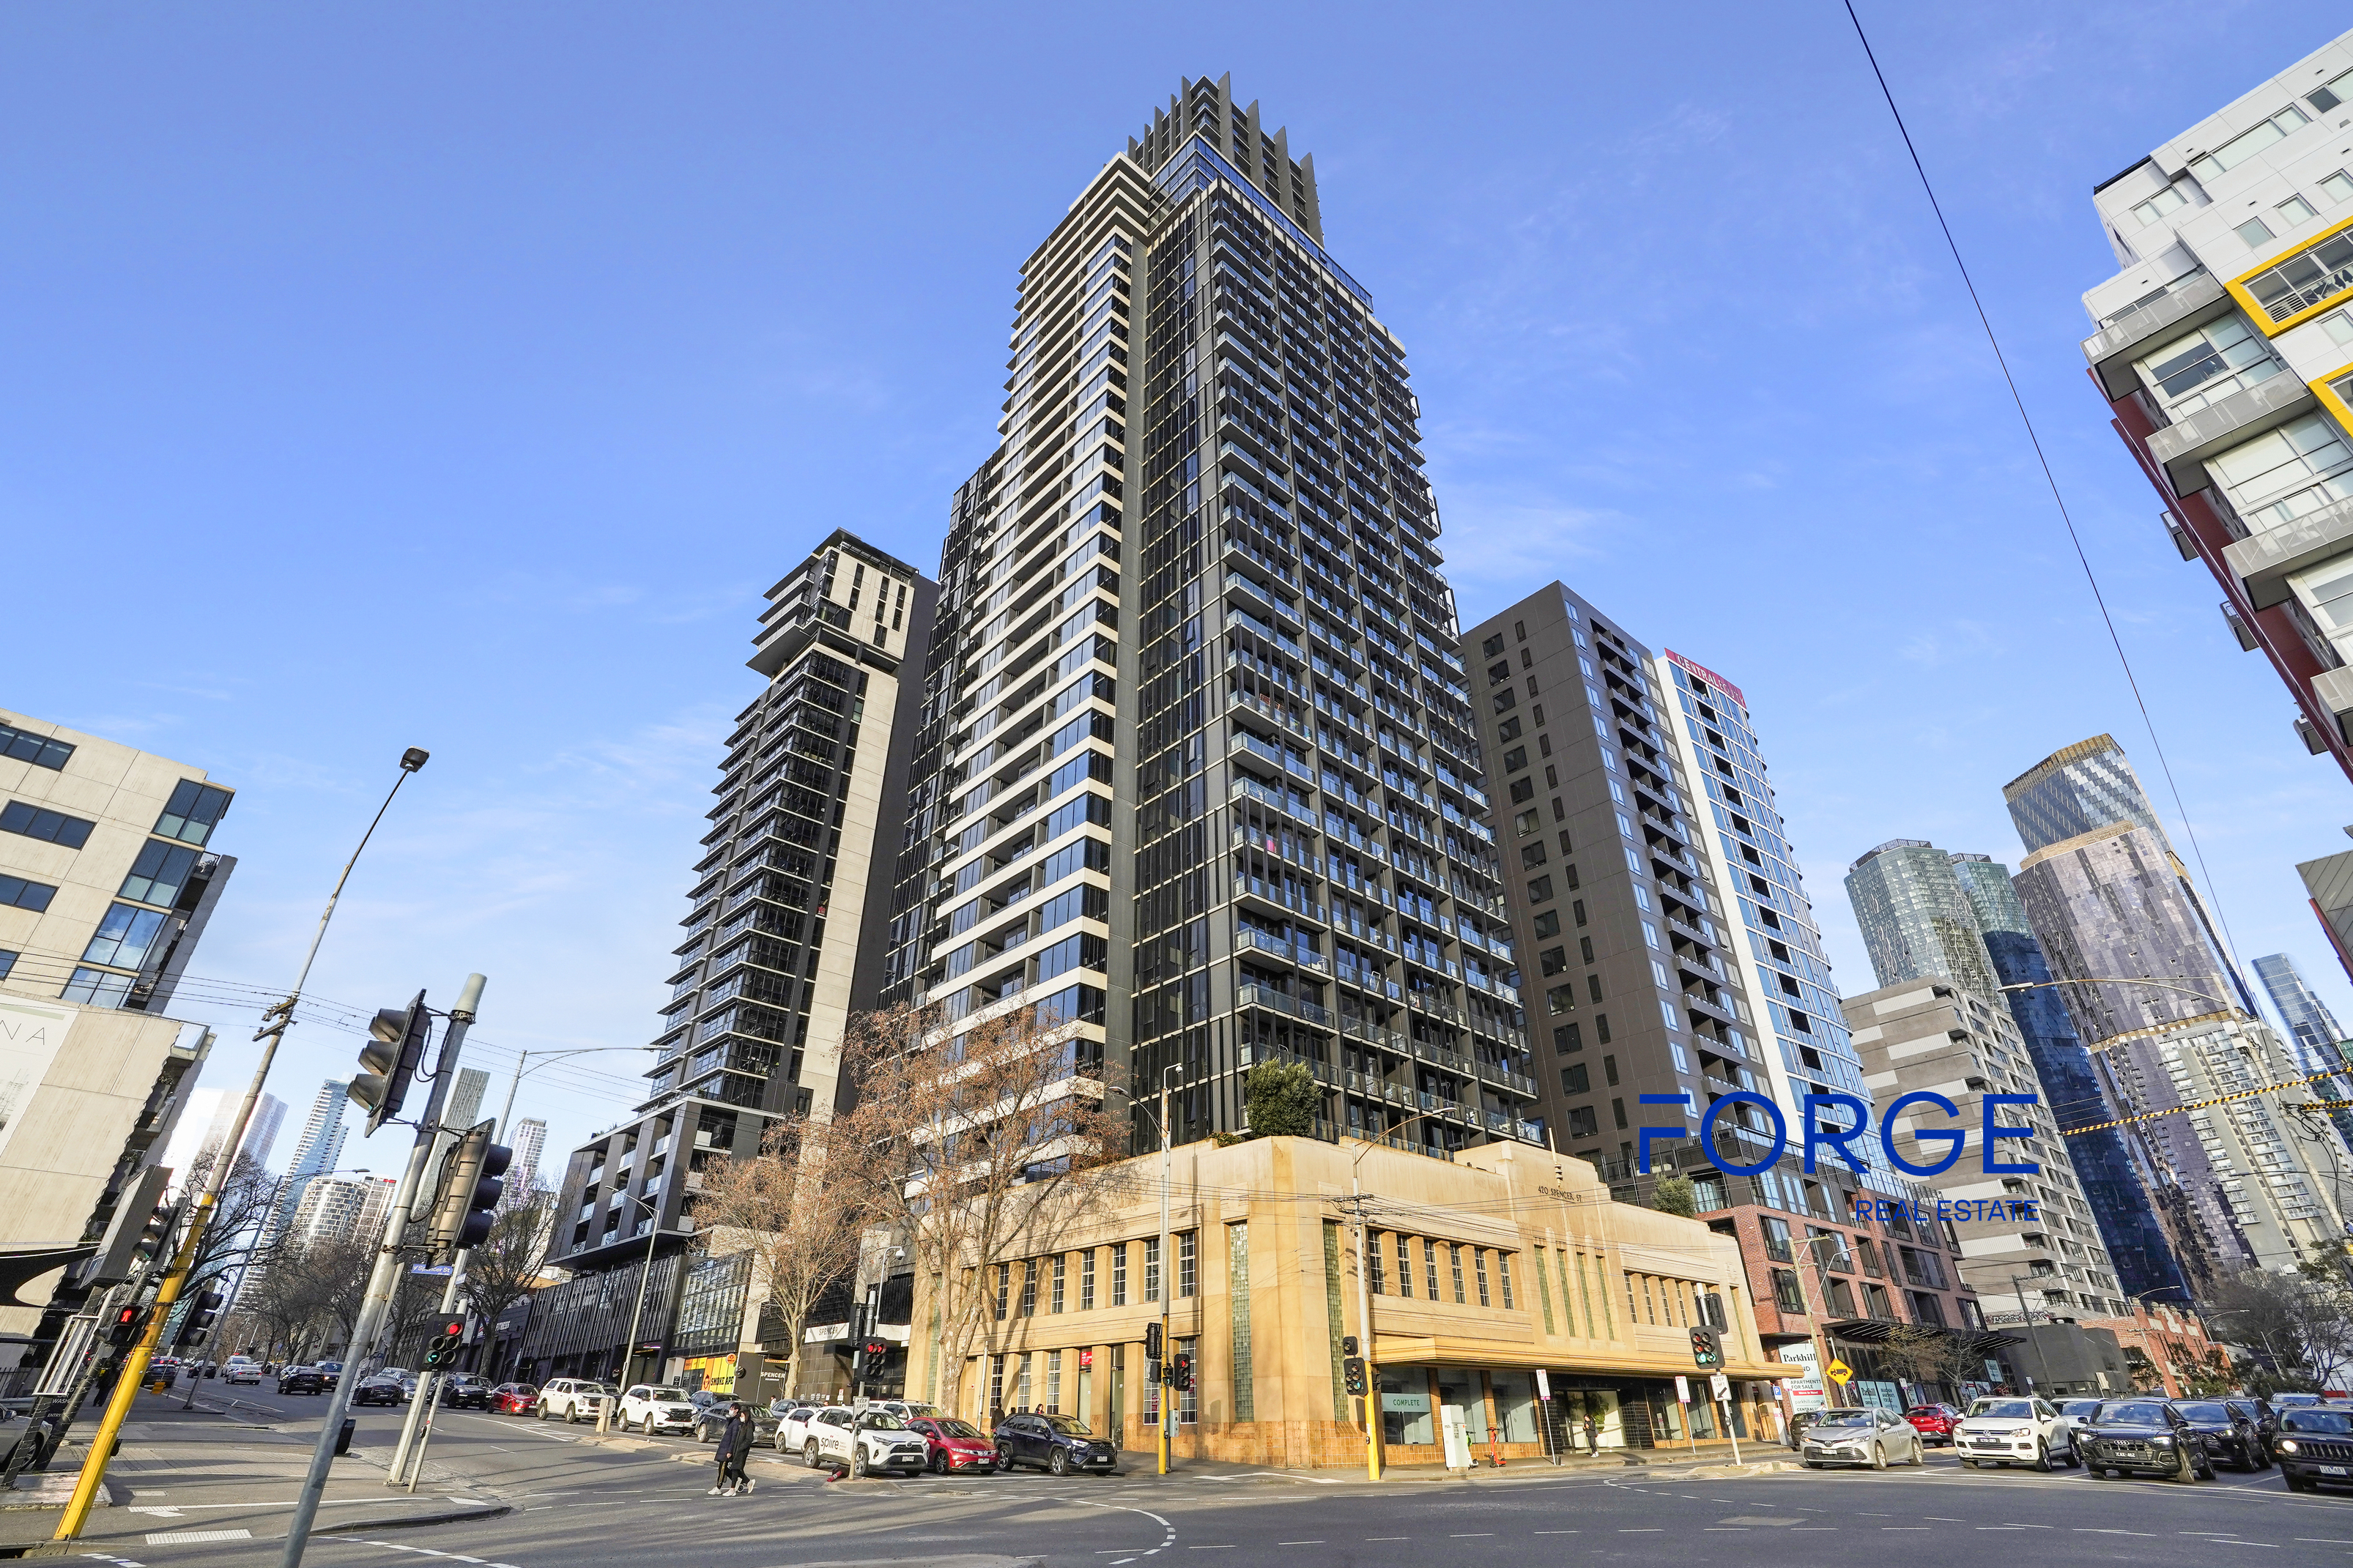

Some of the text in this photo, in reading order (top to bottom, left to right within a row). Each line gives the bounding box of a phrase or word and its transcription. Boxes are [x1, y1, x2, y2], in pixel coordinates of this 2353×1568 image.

[1059, 1183, 1090, 1197] SPENCER
[1095, 1179, 1105, 1189] ST
[1538, 1186, 1582, 1202] 420 SPENCER ST
[1783, 1353, 1816, 1362] Parkhill
[711, 1376, 734, 1386] SMOKE APE
